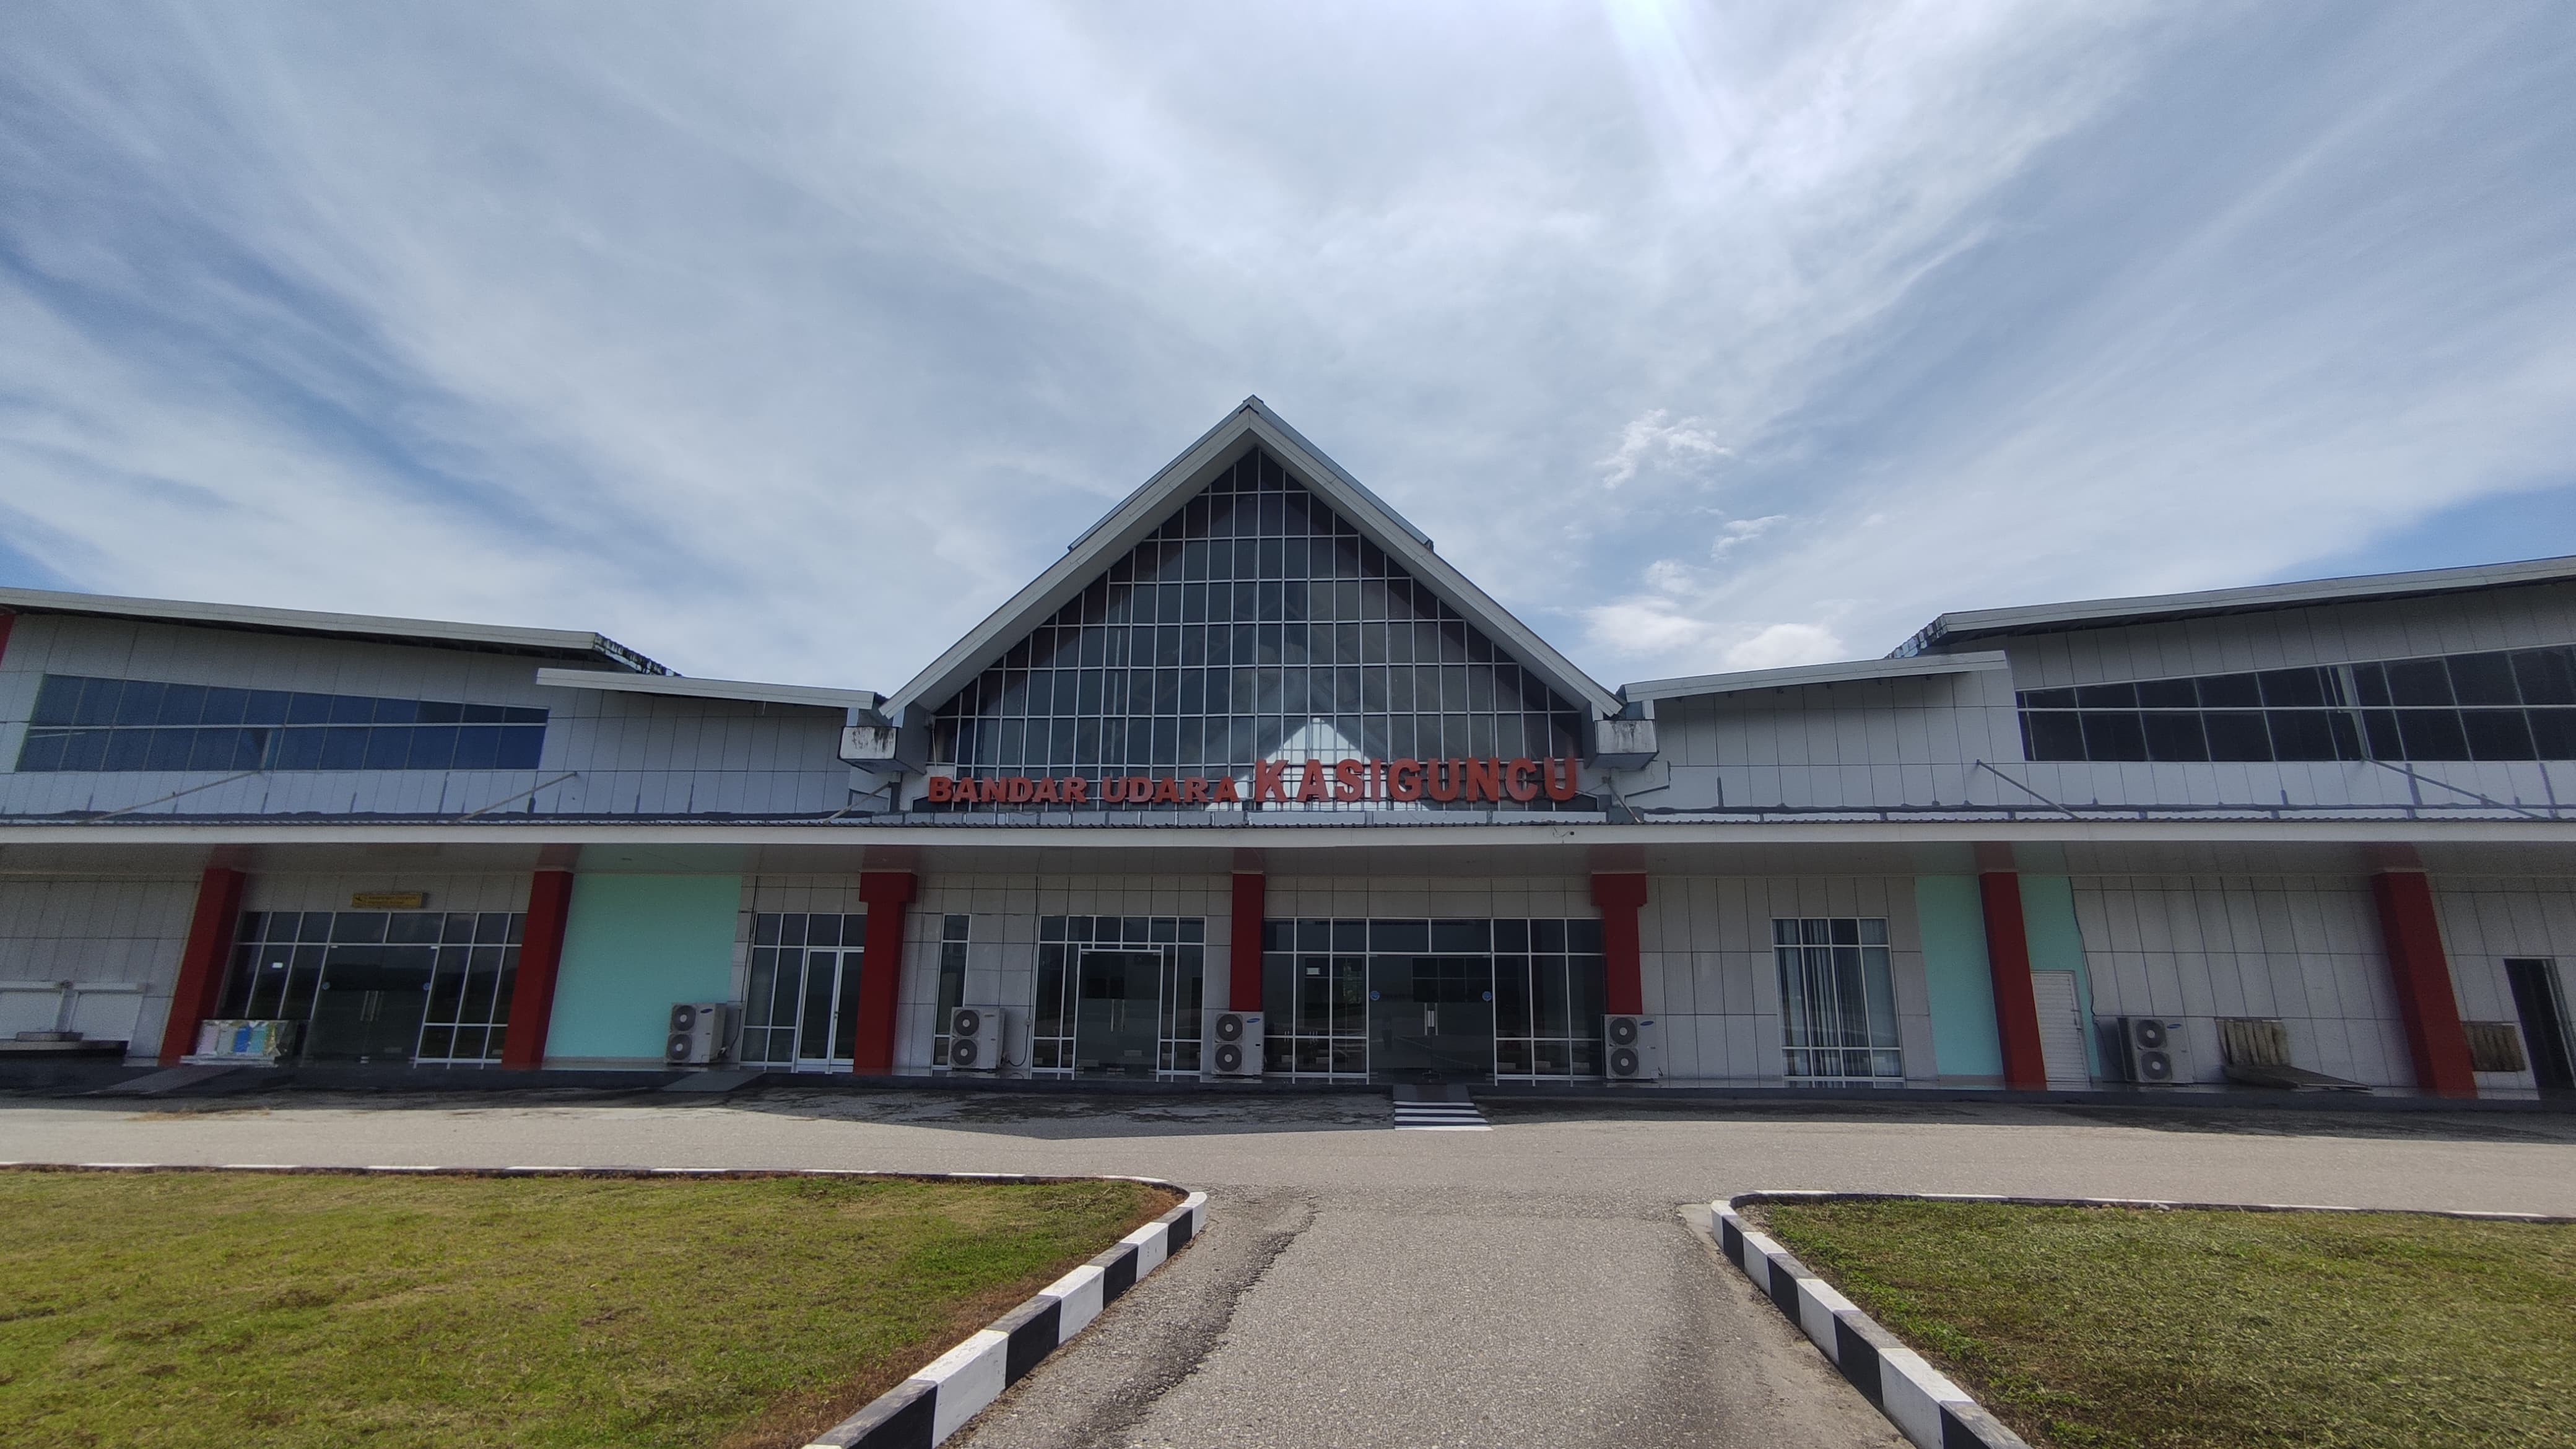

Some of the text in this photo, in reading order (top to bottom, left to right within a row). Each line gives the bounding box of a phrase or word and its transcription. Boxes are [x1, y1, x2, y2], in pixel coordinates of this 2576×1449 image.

[929, 757, 1577, 803] BANDAR UDARA KASIGUNCU
